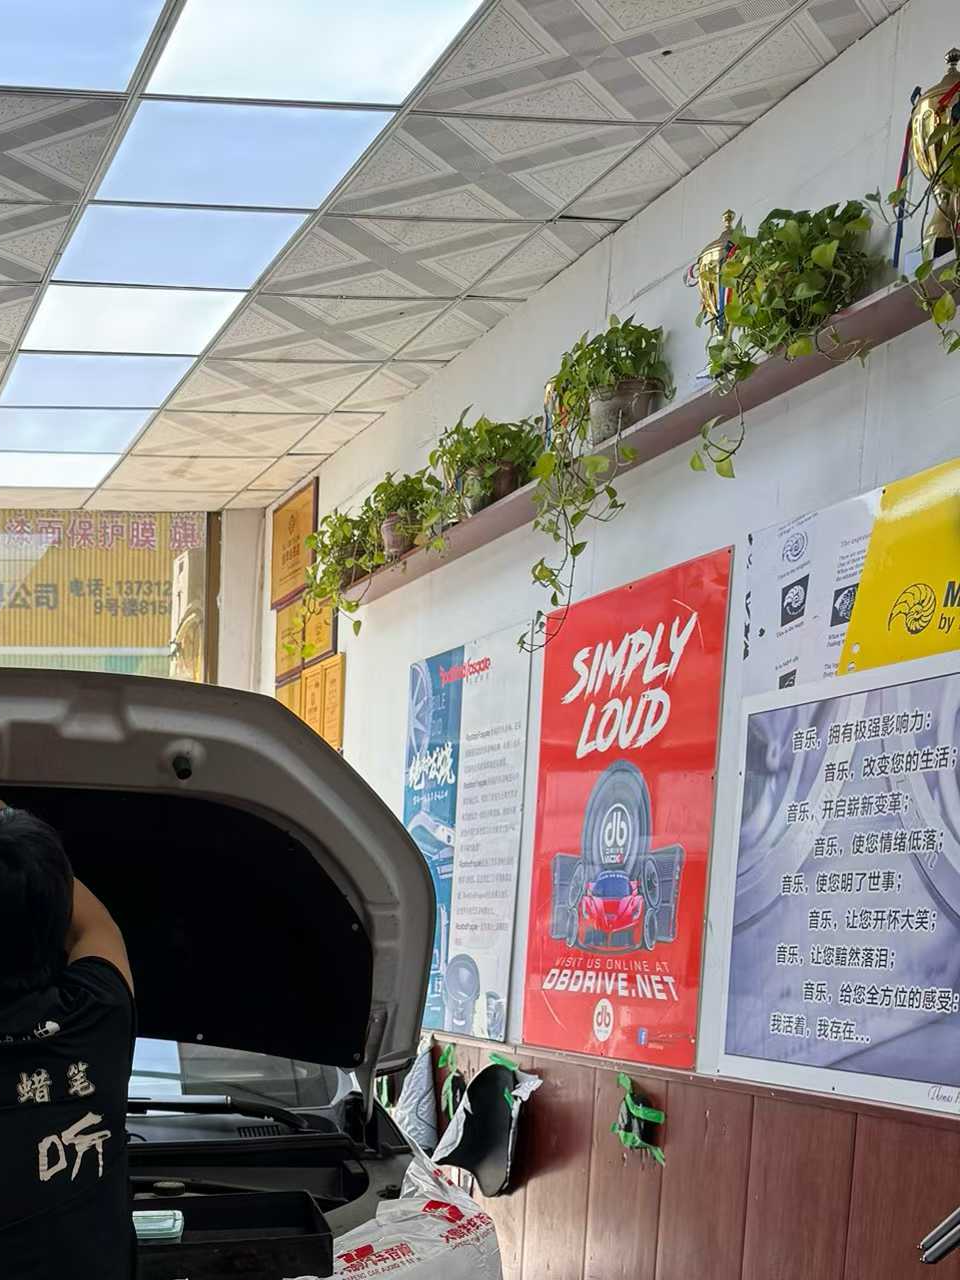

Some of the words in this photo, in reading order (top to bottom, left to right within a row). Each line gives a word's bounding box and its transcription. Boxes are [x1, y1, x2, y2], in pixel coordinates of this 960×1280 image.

[939, 613, 955, 634] by
[561, 611, 698, 704] SIMPLY
[576, 687, 671, 759] LOUD
[555, 956, 582, 968] VISIT
[587, 958, 601, 969] US
[606, 959, 649, 972] ONLINE
[656, 962, 670, 972] AT
[542, 968, 679, 1001] DBDRIVE.NET
